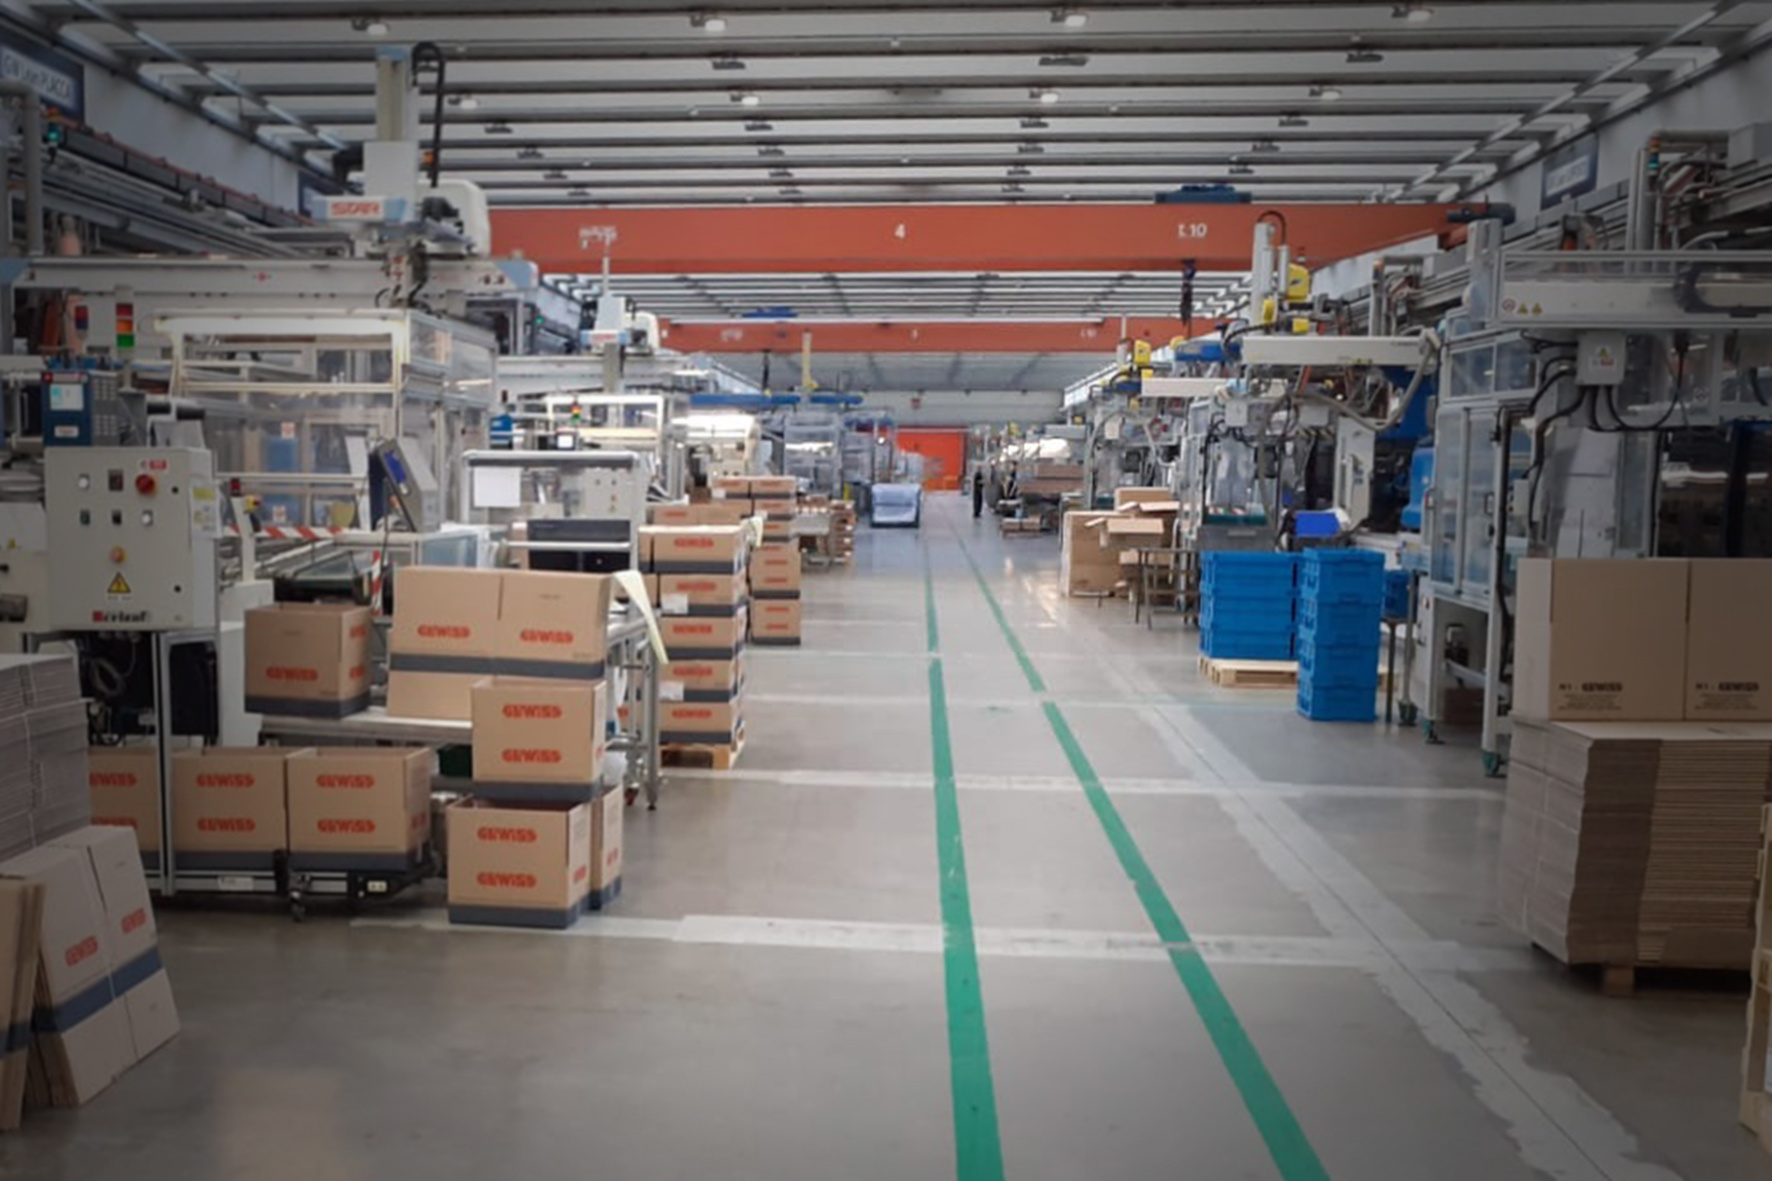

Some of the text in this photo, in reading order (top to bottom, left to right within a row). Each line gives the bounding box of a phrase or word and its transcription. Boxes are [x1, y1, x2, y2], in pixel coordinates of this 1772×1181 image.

[502, 704, 562, 719] GEWISS
[502, 749, 562, 764] GEWISS
[196, 773, 255, 788] GEWISS
[316, 775, 376, 789] GEWISS
[197, 818, 256, 833] GEWISS
[316, 819, 376, 834] GEWISS
[477, 827, 538, 843] GEWISS
[477, 872, 537, 889] GEWISS
